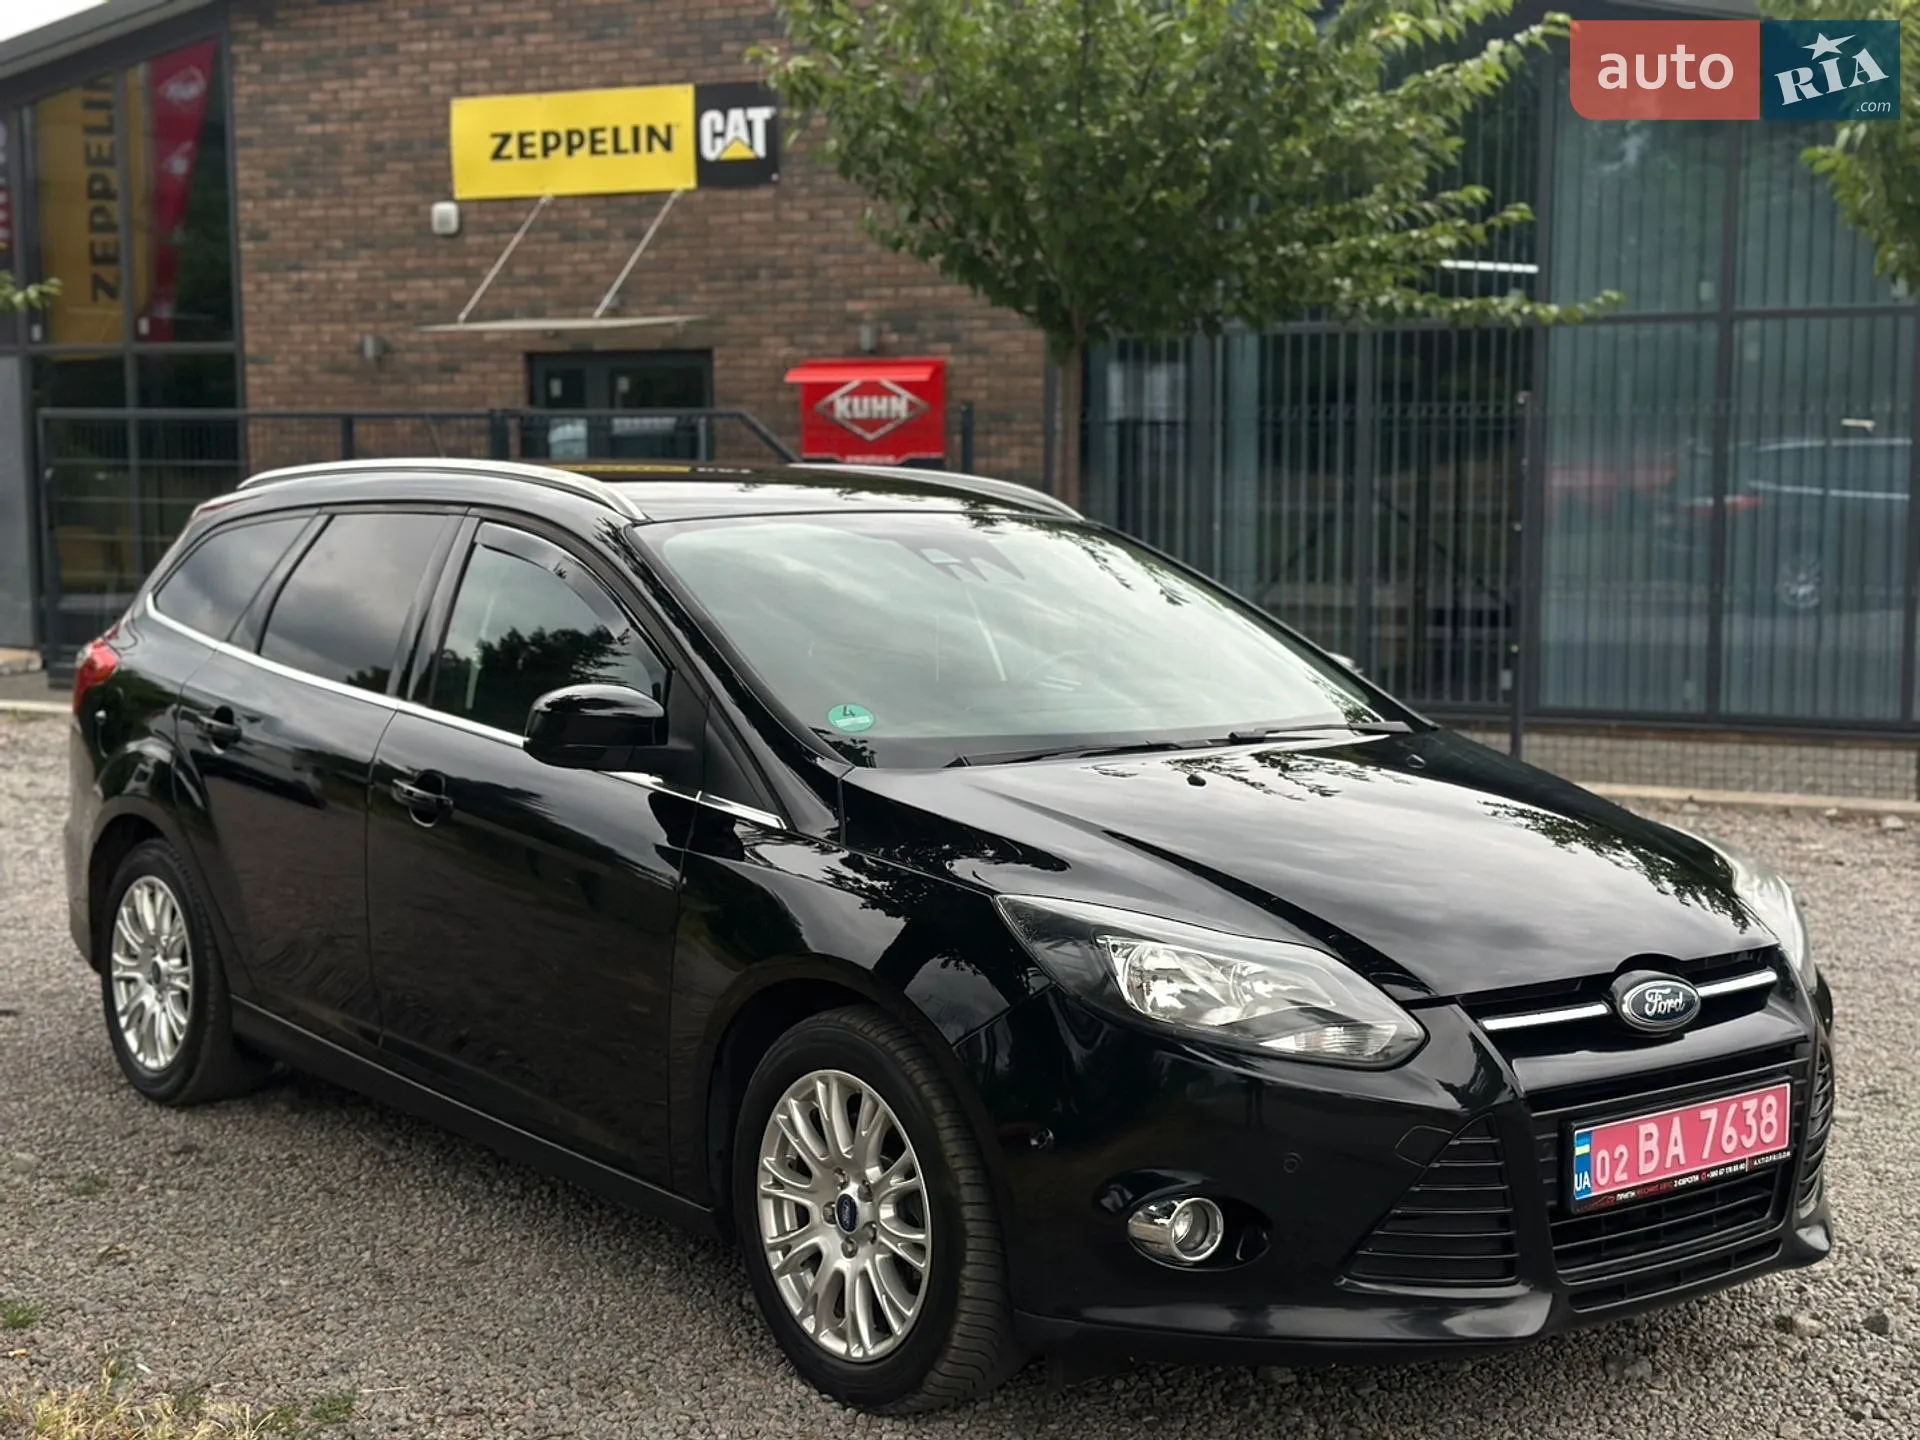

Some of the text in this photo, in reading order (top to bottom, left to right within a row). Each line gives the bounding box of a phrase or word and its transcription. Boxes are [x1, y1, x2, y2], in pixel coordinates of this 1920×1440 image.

[490, 123, 673, 161] ZEPPELIN
[700, 106, 774, 161] CAT
[834, 395, 908, 419] KUHN
[1644, 987, 1685, 1017] Ford
[1596, 1094, 1778, 1185] 02 BA 7638
[1574, 1173, 1591, 1191] UA
